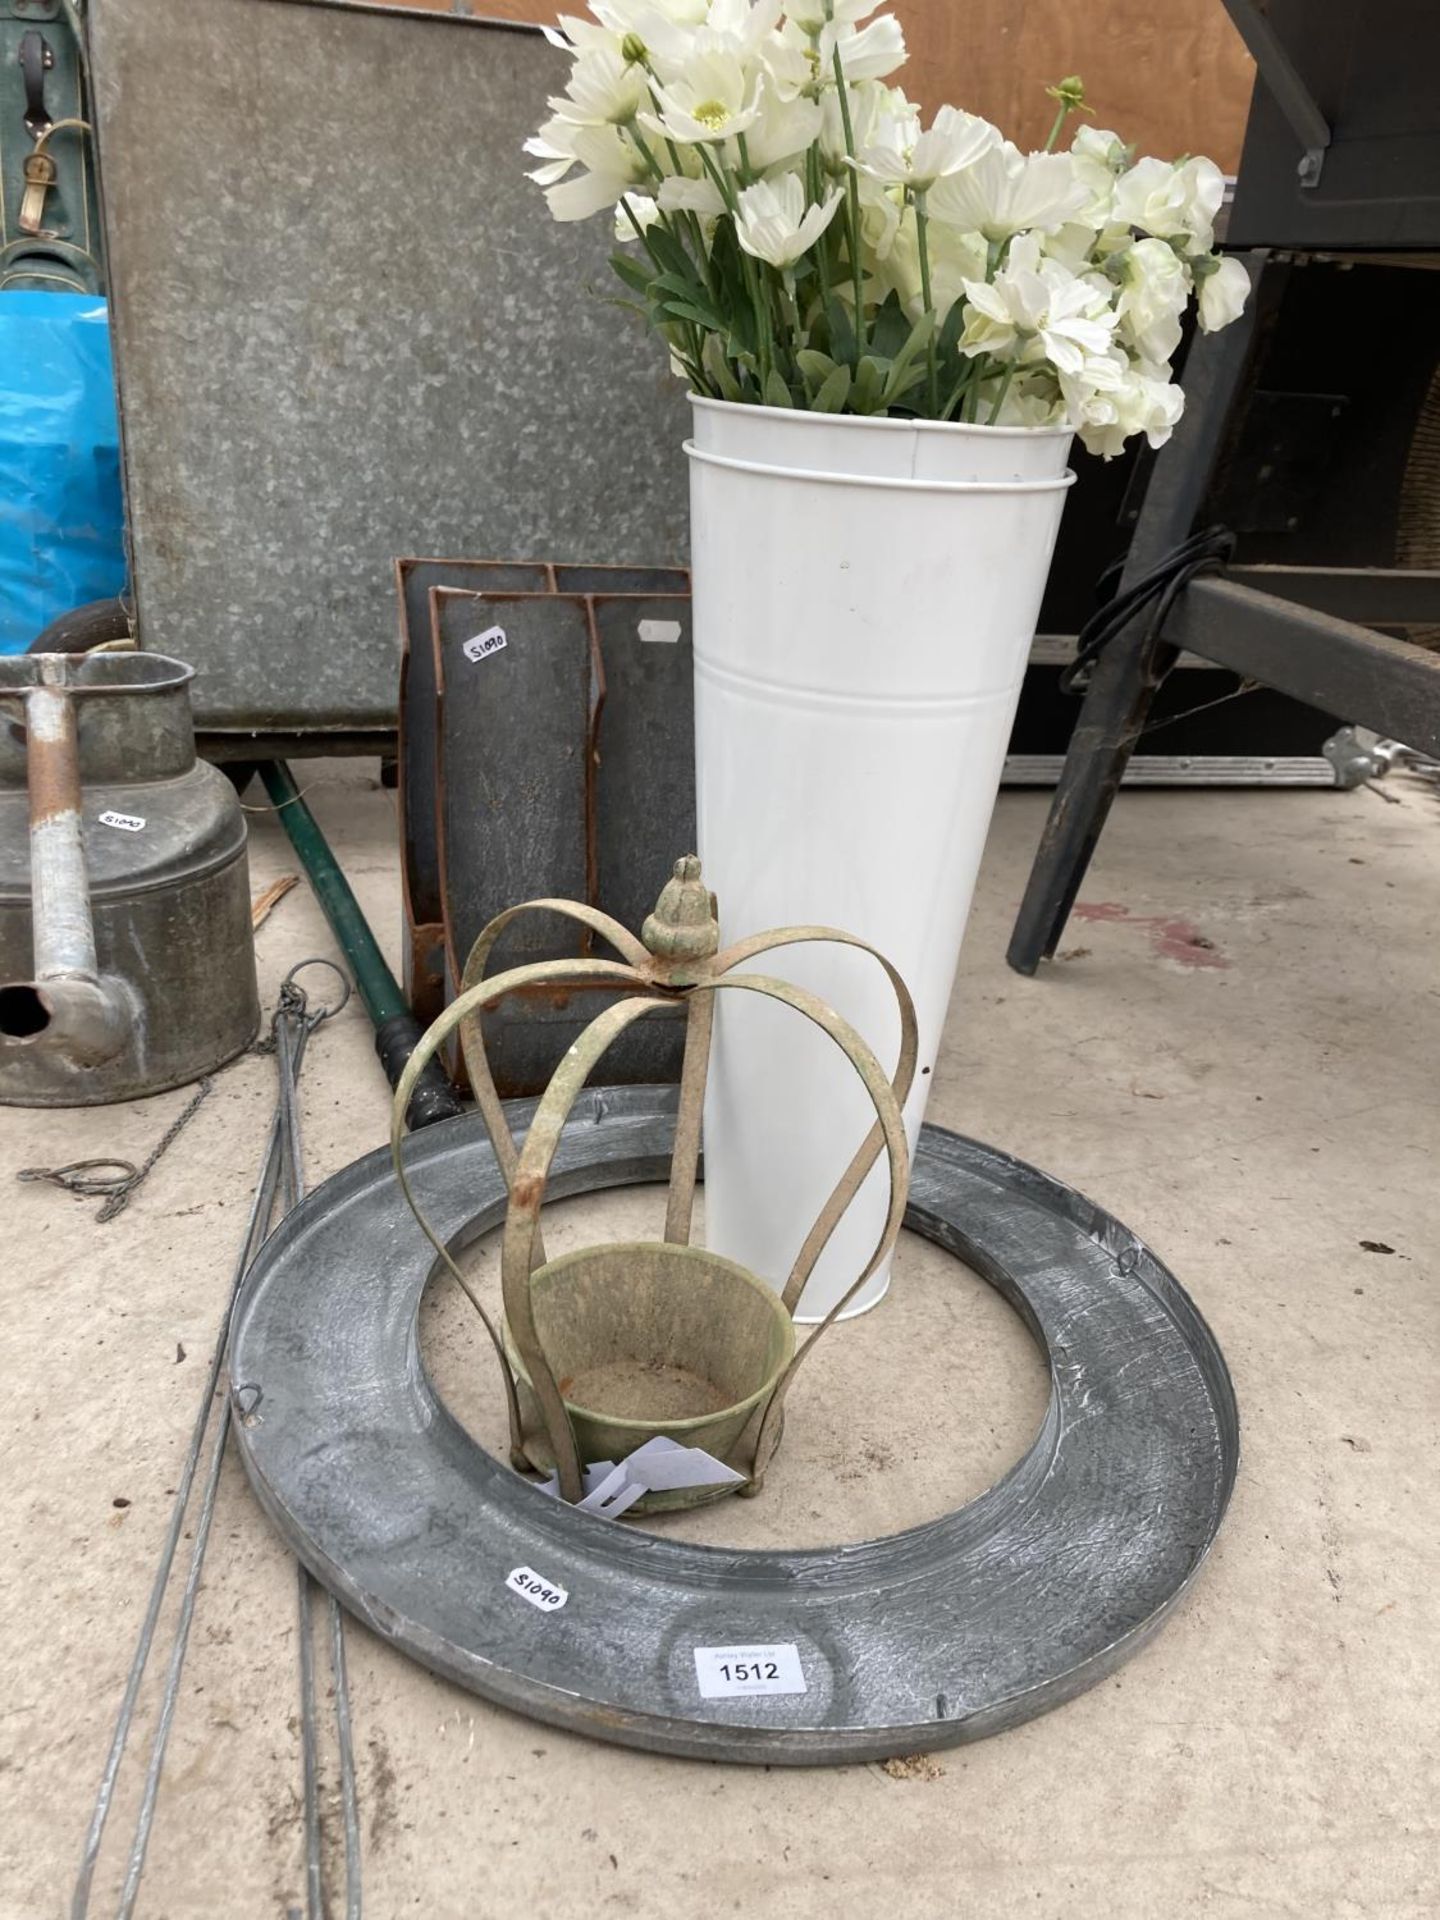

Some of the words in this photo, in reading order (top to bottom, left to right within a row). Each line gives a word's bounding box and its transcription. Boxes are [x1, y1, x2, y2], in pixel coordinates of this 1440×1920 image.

[470, 635, 504, 658] S1090
[513, 1573, 560, 1604] S1090
[719, 1662, 780, 1681] 1512
